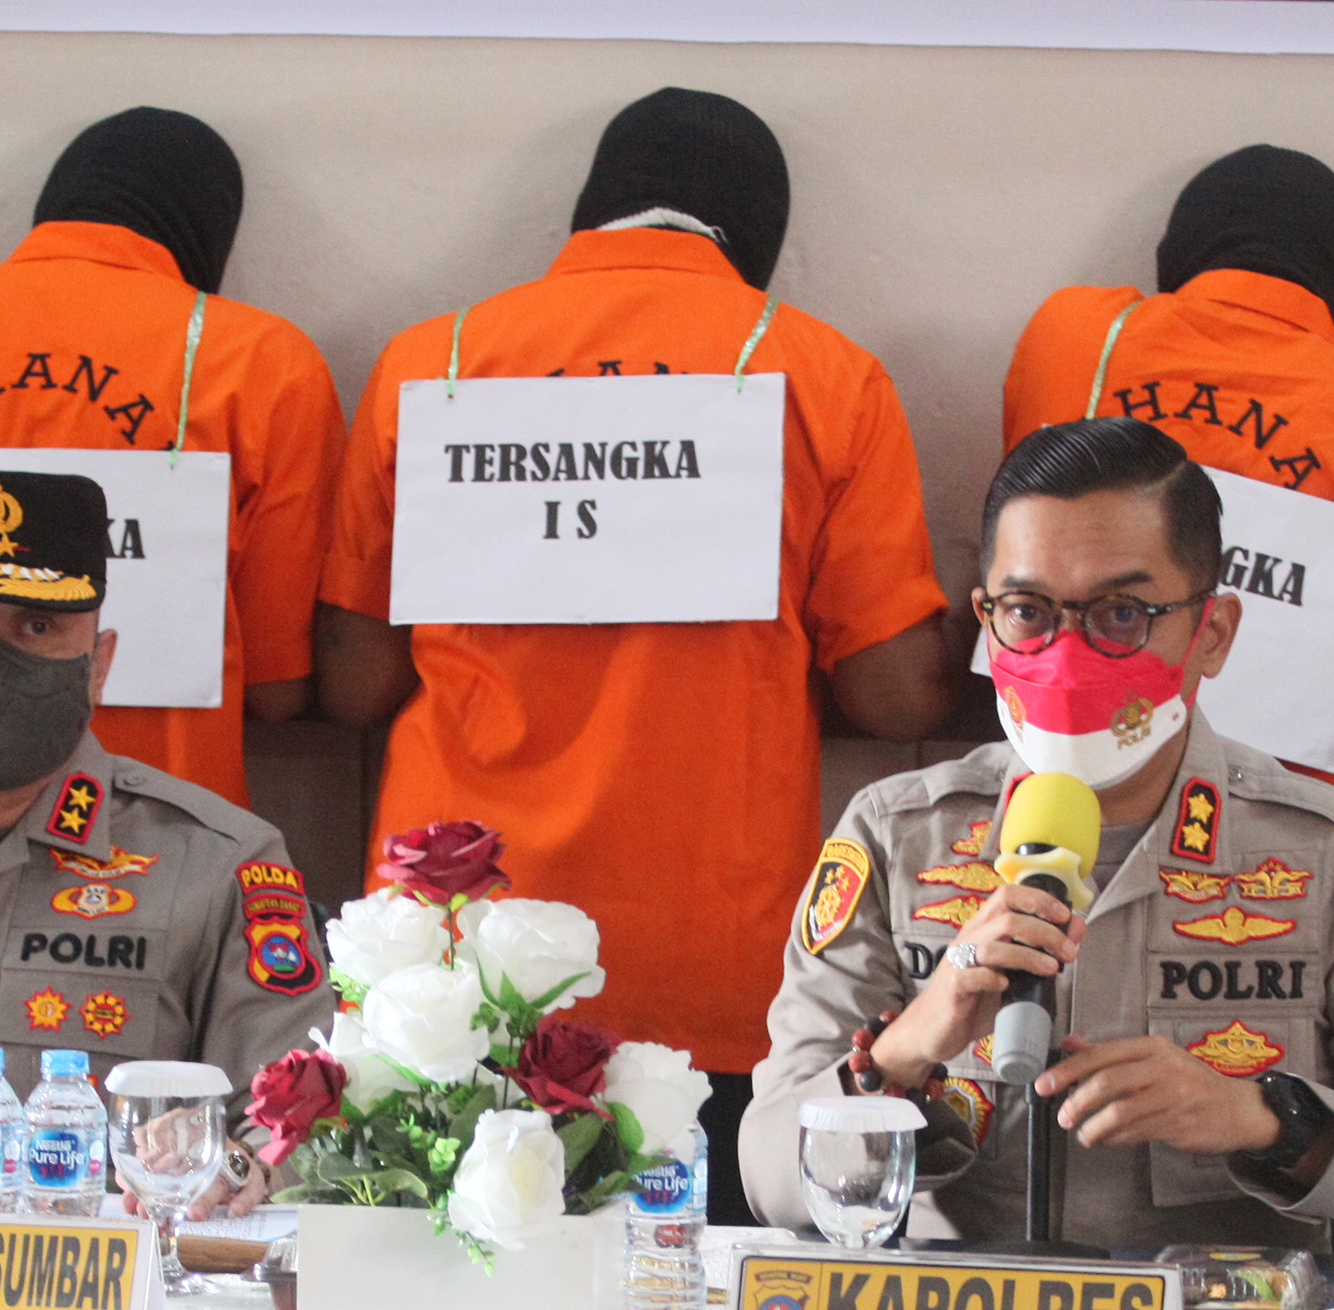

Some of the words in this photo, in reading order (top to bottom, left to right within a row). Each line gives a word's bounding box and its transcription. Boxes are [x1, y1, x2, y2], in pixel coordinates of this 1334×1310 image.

[445, 440, 701, 483] TERSANGKA
[543, 501, 561, 539] I
[577, 499, 597, 539] S
[240, 865, 299, 891] POLDA
[20, 932, 147, 971] POLRI
[1158, 959, 1308, 1001] POLRI
[28, 1149, 60, 1165] Pure
[60, 1151, 85, 1170] Life
[663, 1176, 689, 1197] Life
